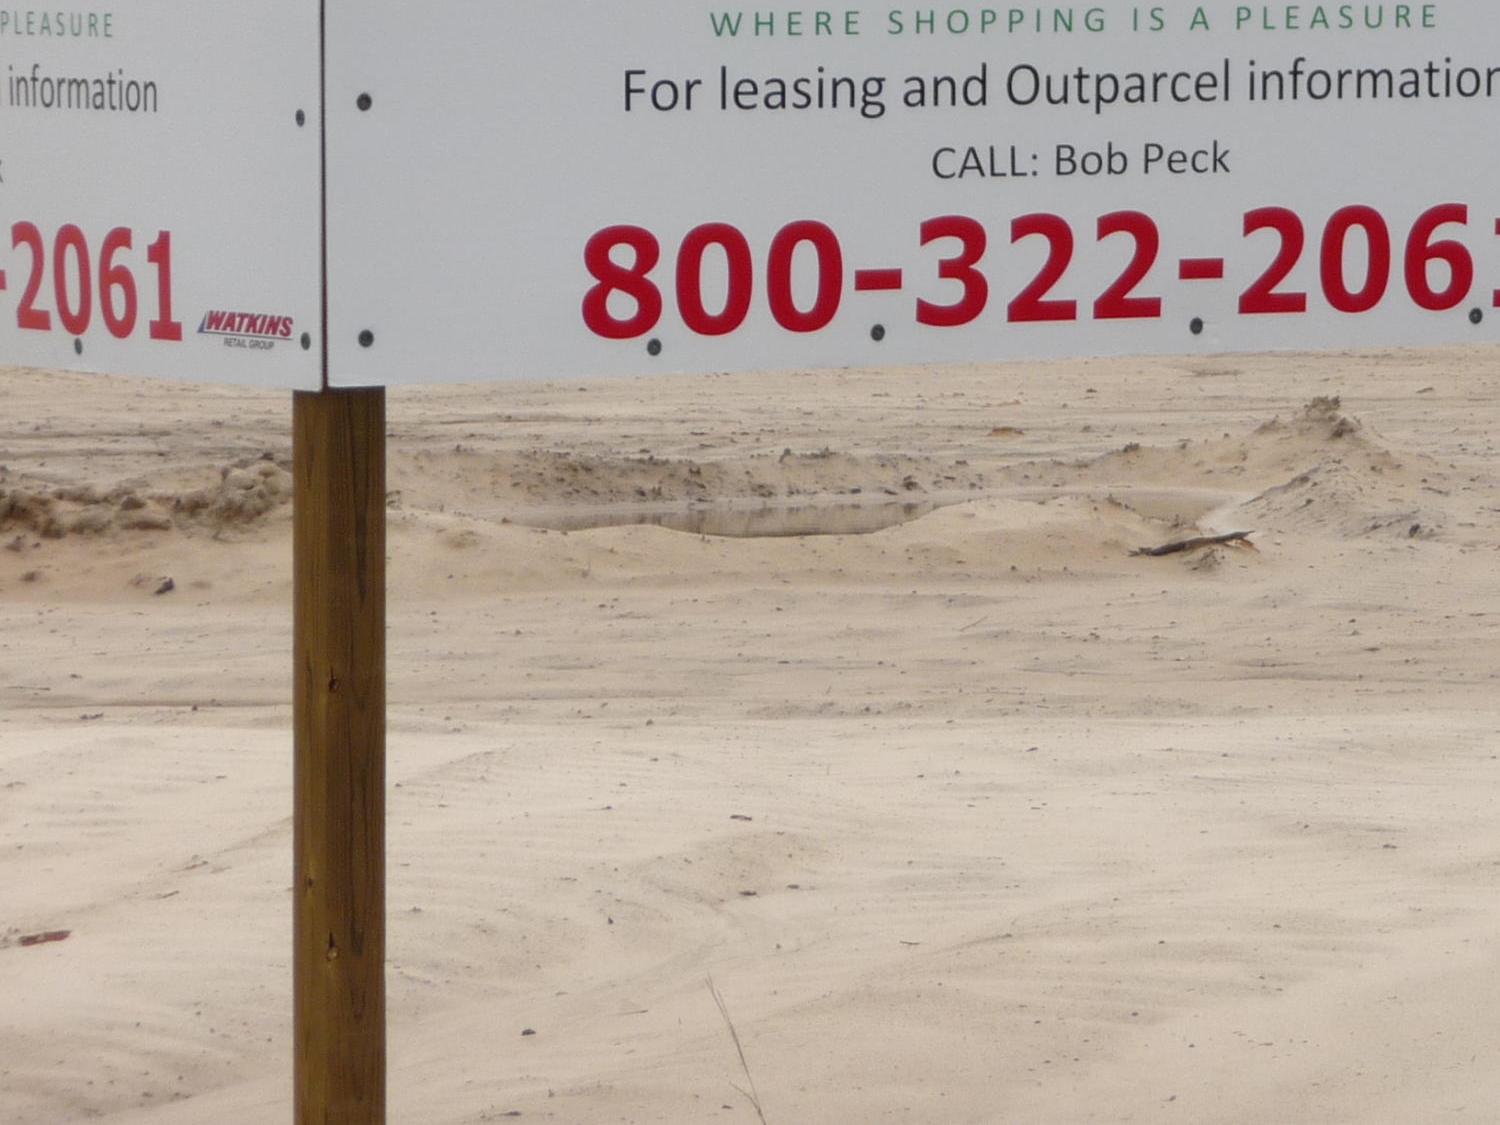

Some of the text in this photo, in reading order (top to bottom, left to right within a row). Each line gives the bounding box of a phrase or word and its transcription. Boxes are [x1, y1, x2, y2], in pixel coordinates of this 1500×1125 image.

[0, 10, 114, 38] PLEASURE
[709, 3, 1437, 37] WHERE SHOPPING IS A PLEASURE
[8, 63, 159, 113] information
[623, 69, 703, 112] For
[719, 64, 887, 119] leasing
[902, 62, 989, 107] and
[1006, 57, 1230, 115] Outparcel
[931, 139, 1232, 179] CALL: Bob Peck
[206, 309, 294, 337] WATKINS
[223, 337, 275, 351] RETAIL GROUP
